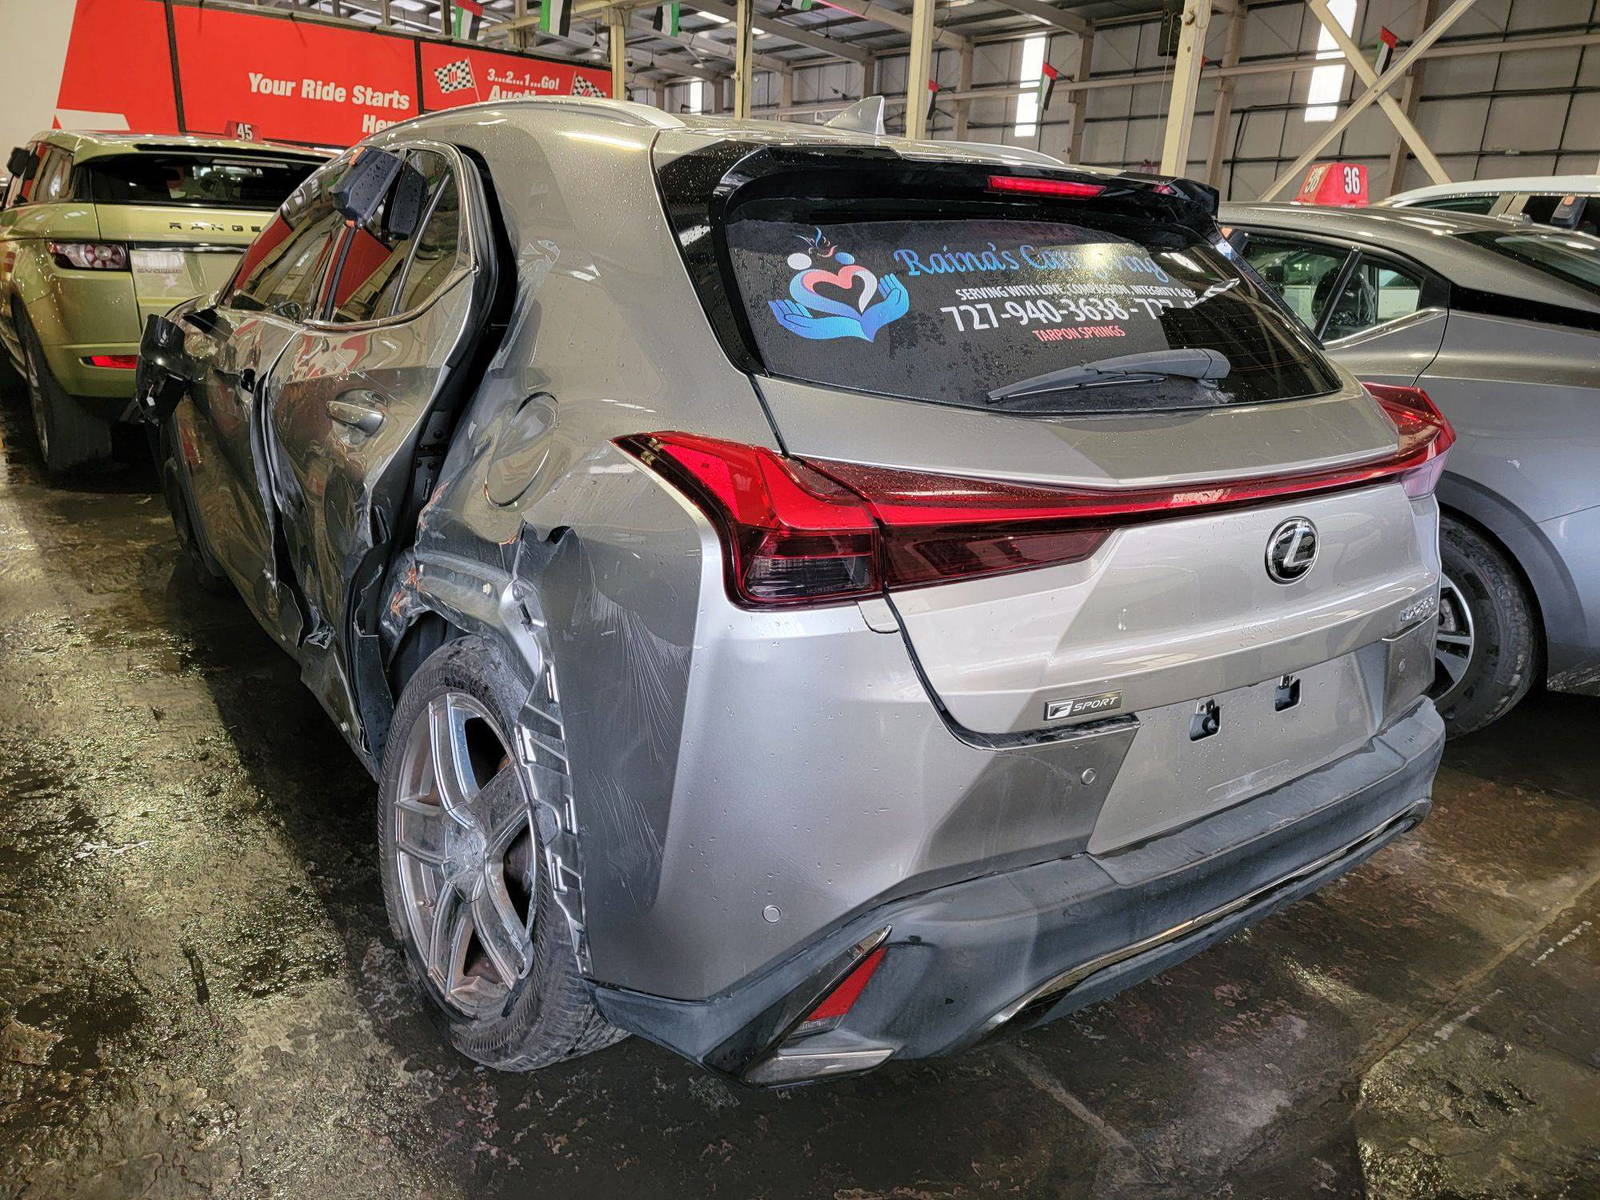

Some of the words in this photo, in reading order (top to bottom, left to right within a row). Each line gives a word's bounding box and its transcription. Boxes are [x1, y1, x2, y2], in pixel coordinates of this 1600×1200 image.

[248, 72, 296, 96] Your
[301, 79, 347, 103] Ride
[352, 85, 410, 110] Starts
[236, 123, 253, 140] 45
[1343, 166, 1361, 194] 36
[893, 242, 1020, 276] Raina's
[955, 286, 1007, 301] SERVING
[1006, 284, 1036, 297] WITH
[940, 299, 1130, 332] 727-940-3638
[1032, 328, 1080, 342] TARPON
[1078, 325, 1127, 340] SPRINGS
[1072, 696, 1119, 712] SPORT
